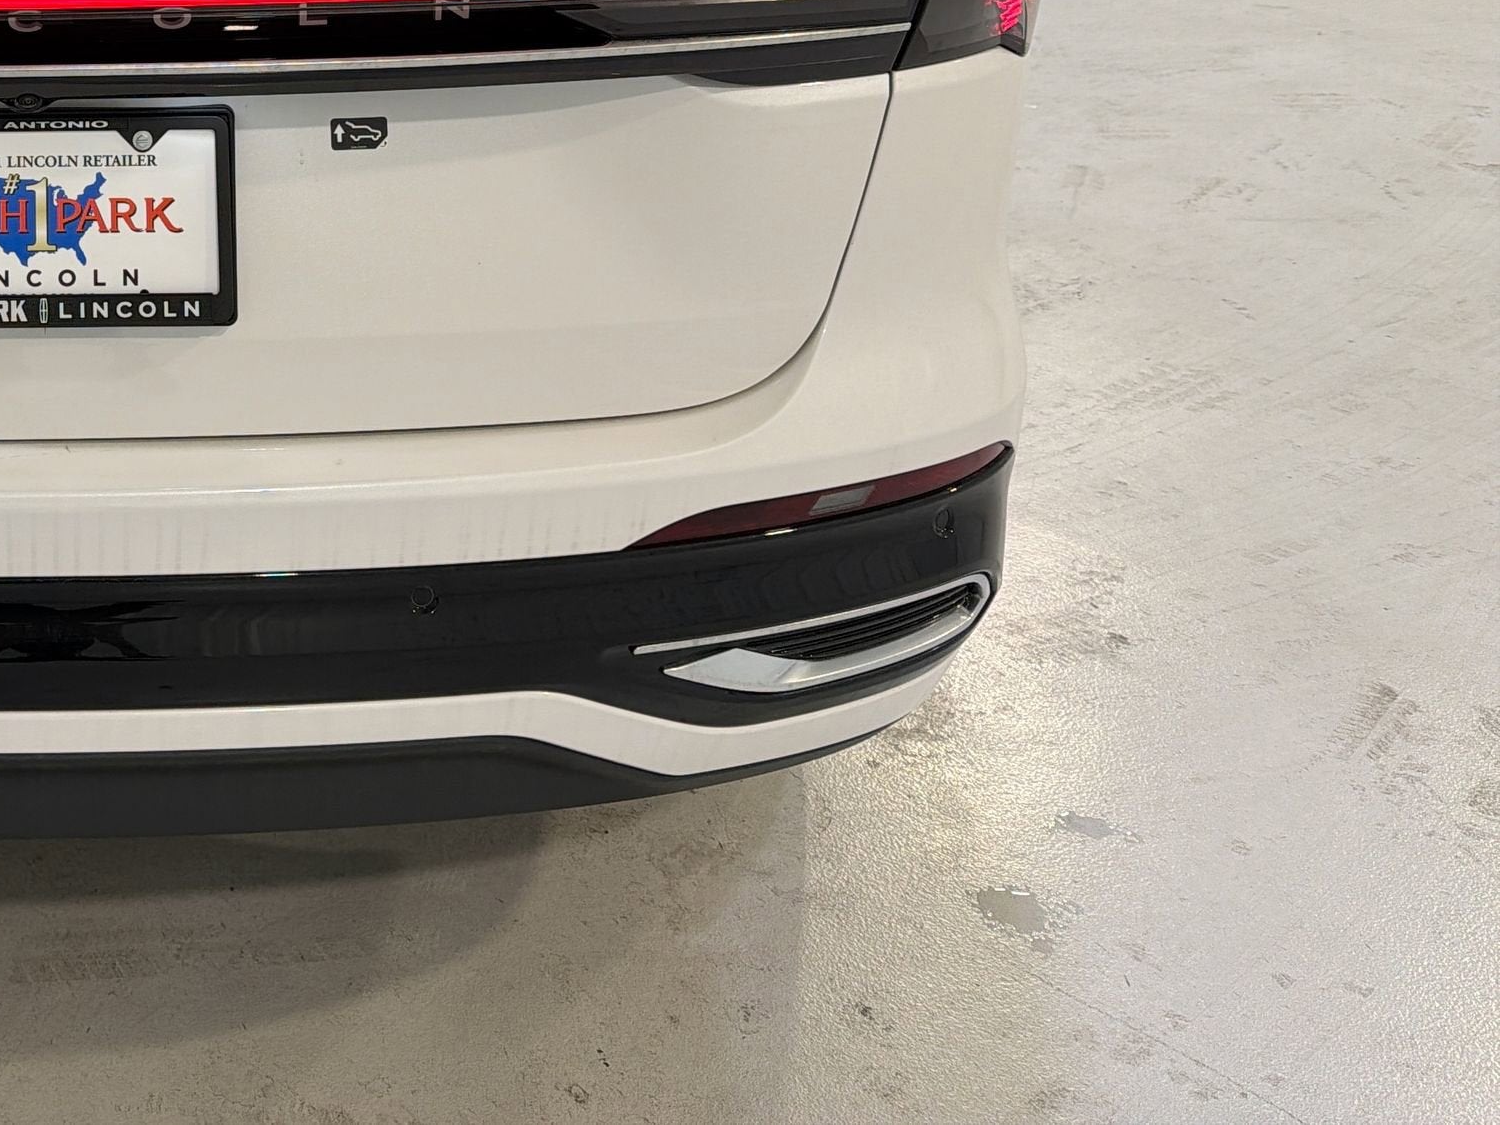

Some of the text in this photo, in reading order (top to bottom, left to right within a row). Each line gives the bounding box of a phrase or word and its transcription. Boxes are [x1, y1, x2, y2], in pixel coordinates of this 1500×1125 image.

[4, 120, 109, 129] ANTONIO
[7, 155, 78, 168] LINCOLN
[83, 154, 158, 167] RETAILER
[55, 197, 184, 233] PARK
[59, 300, 201, 319] LINCOLN
